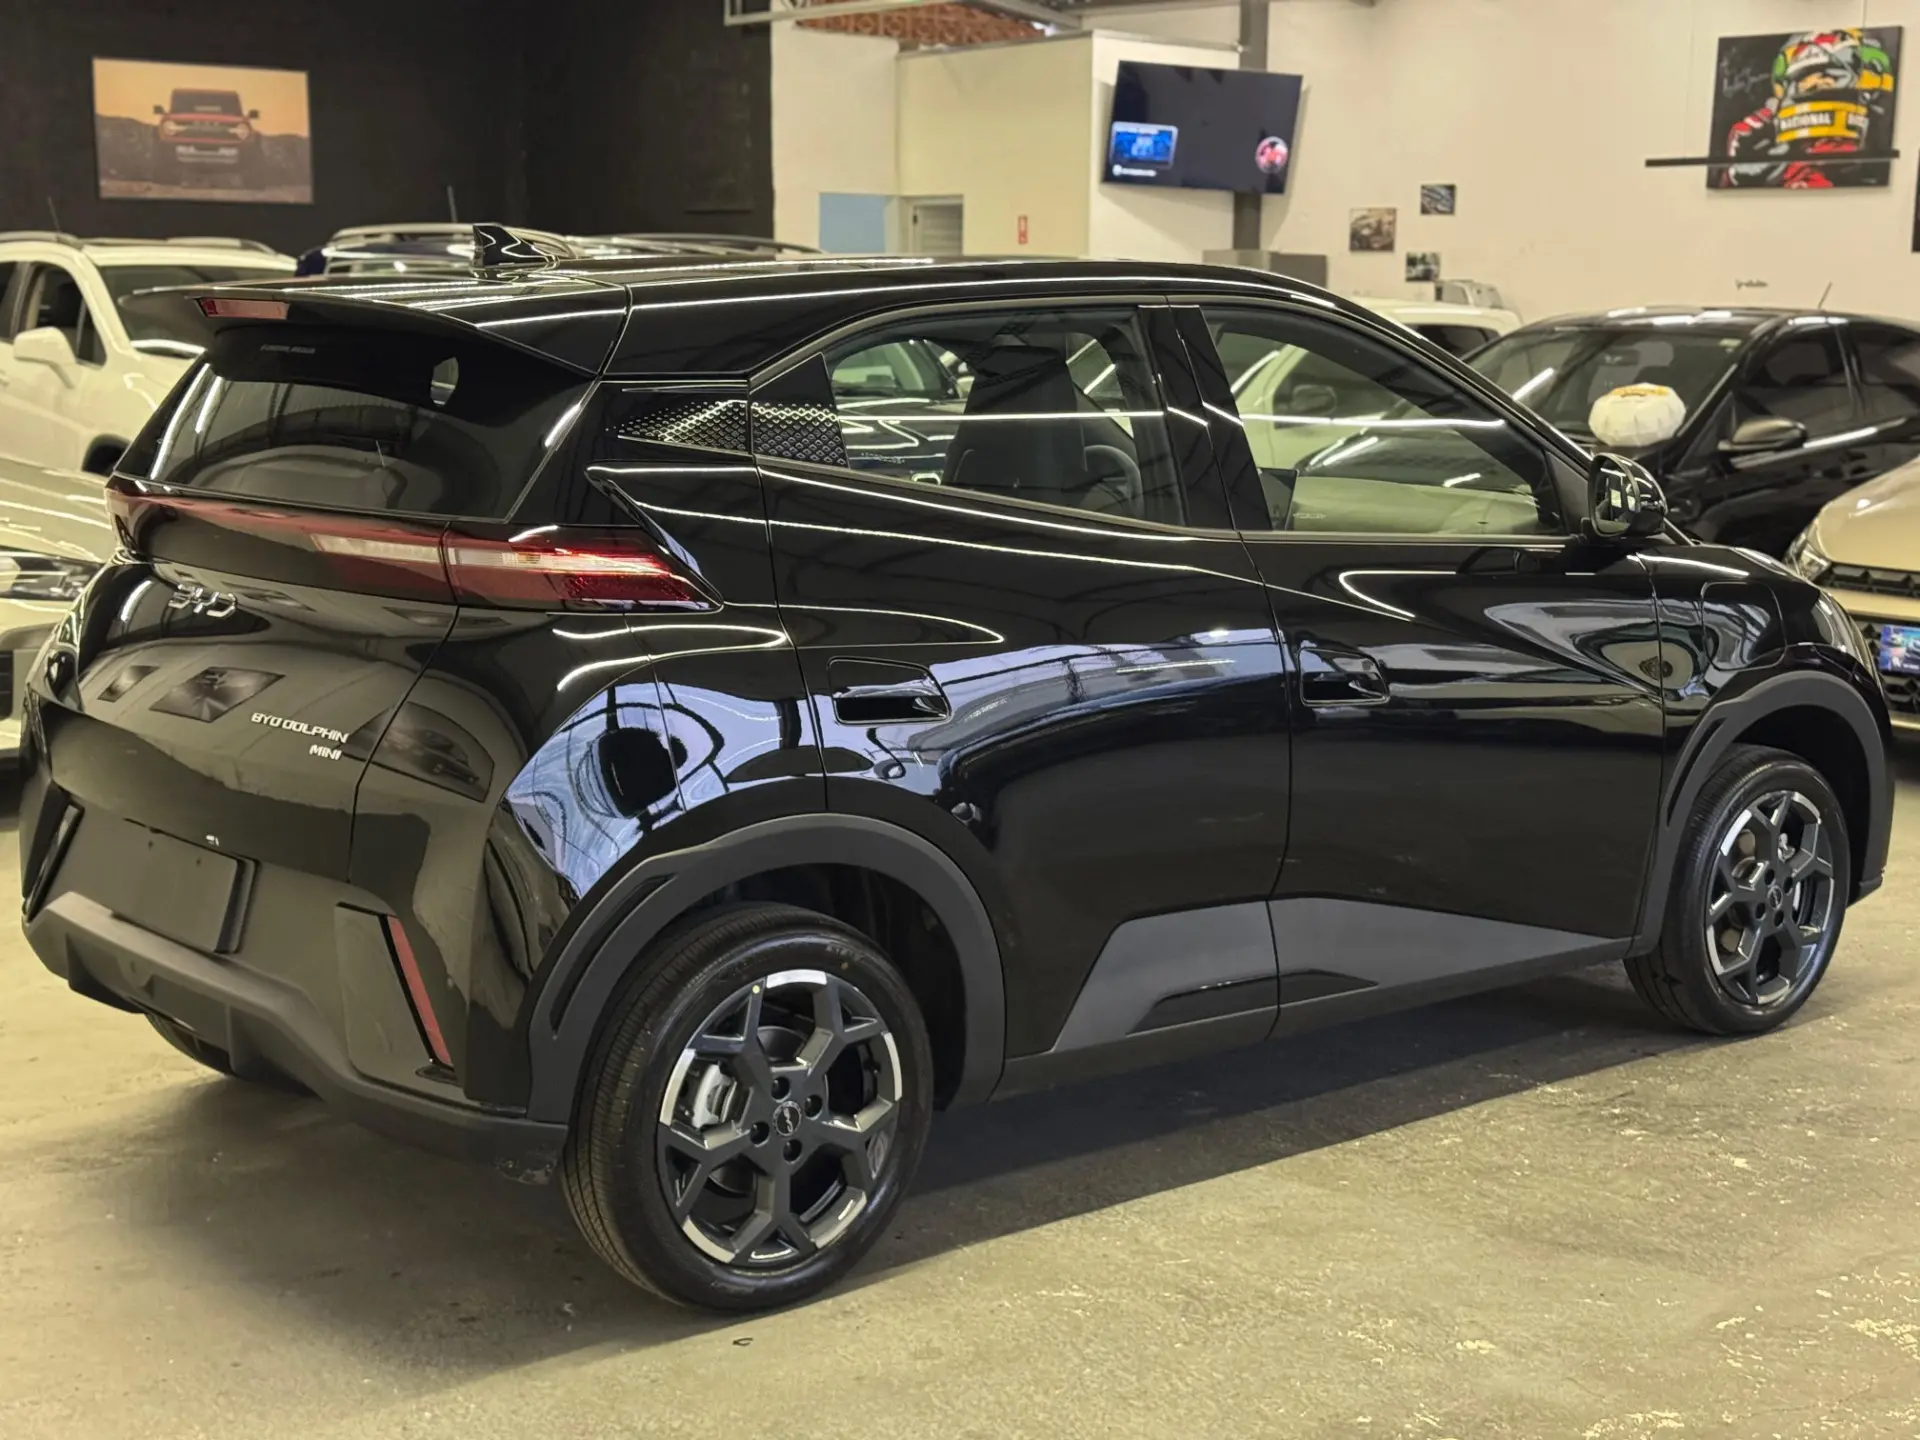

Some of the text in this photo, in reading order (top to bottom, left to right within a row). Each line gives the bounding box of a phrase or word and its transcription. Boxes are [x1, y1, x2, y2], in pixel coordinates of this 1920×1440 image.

[168, 584, 237, 618] BYD
[251, 712, 350, 743] BYD DOLPHIN
[309, 744, 342, 760] MINI
